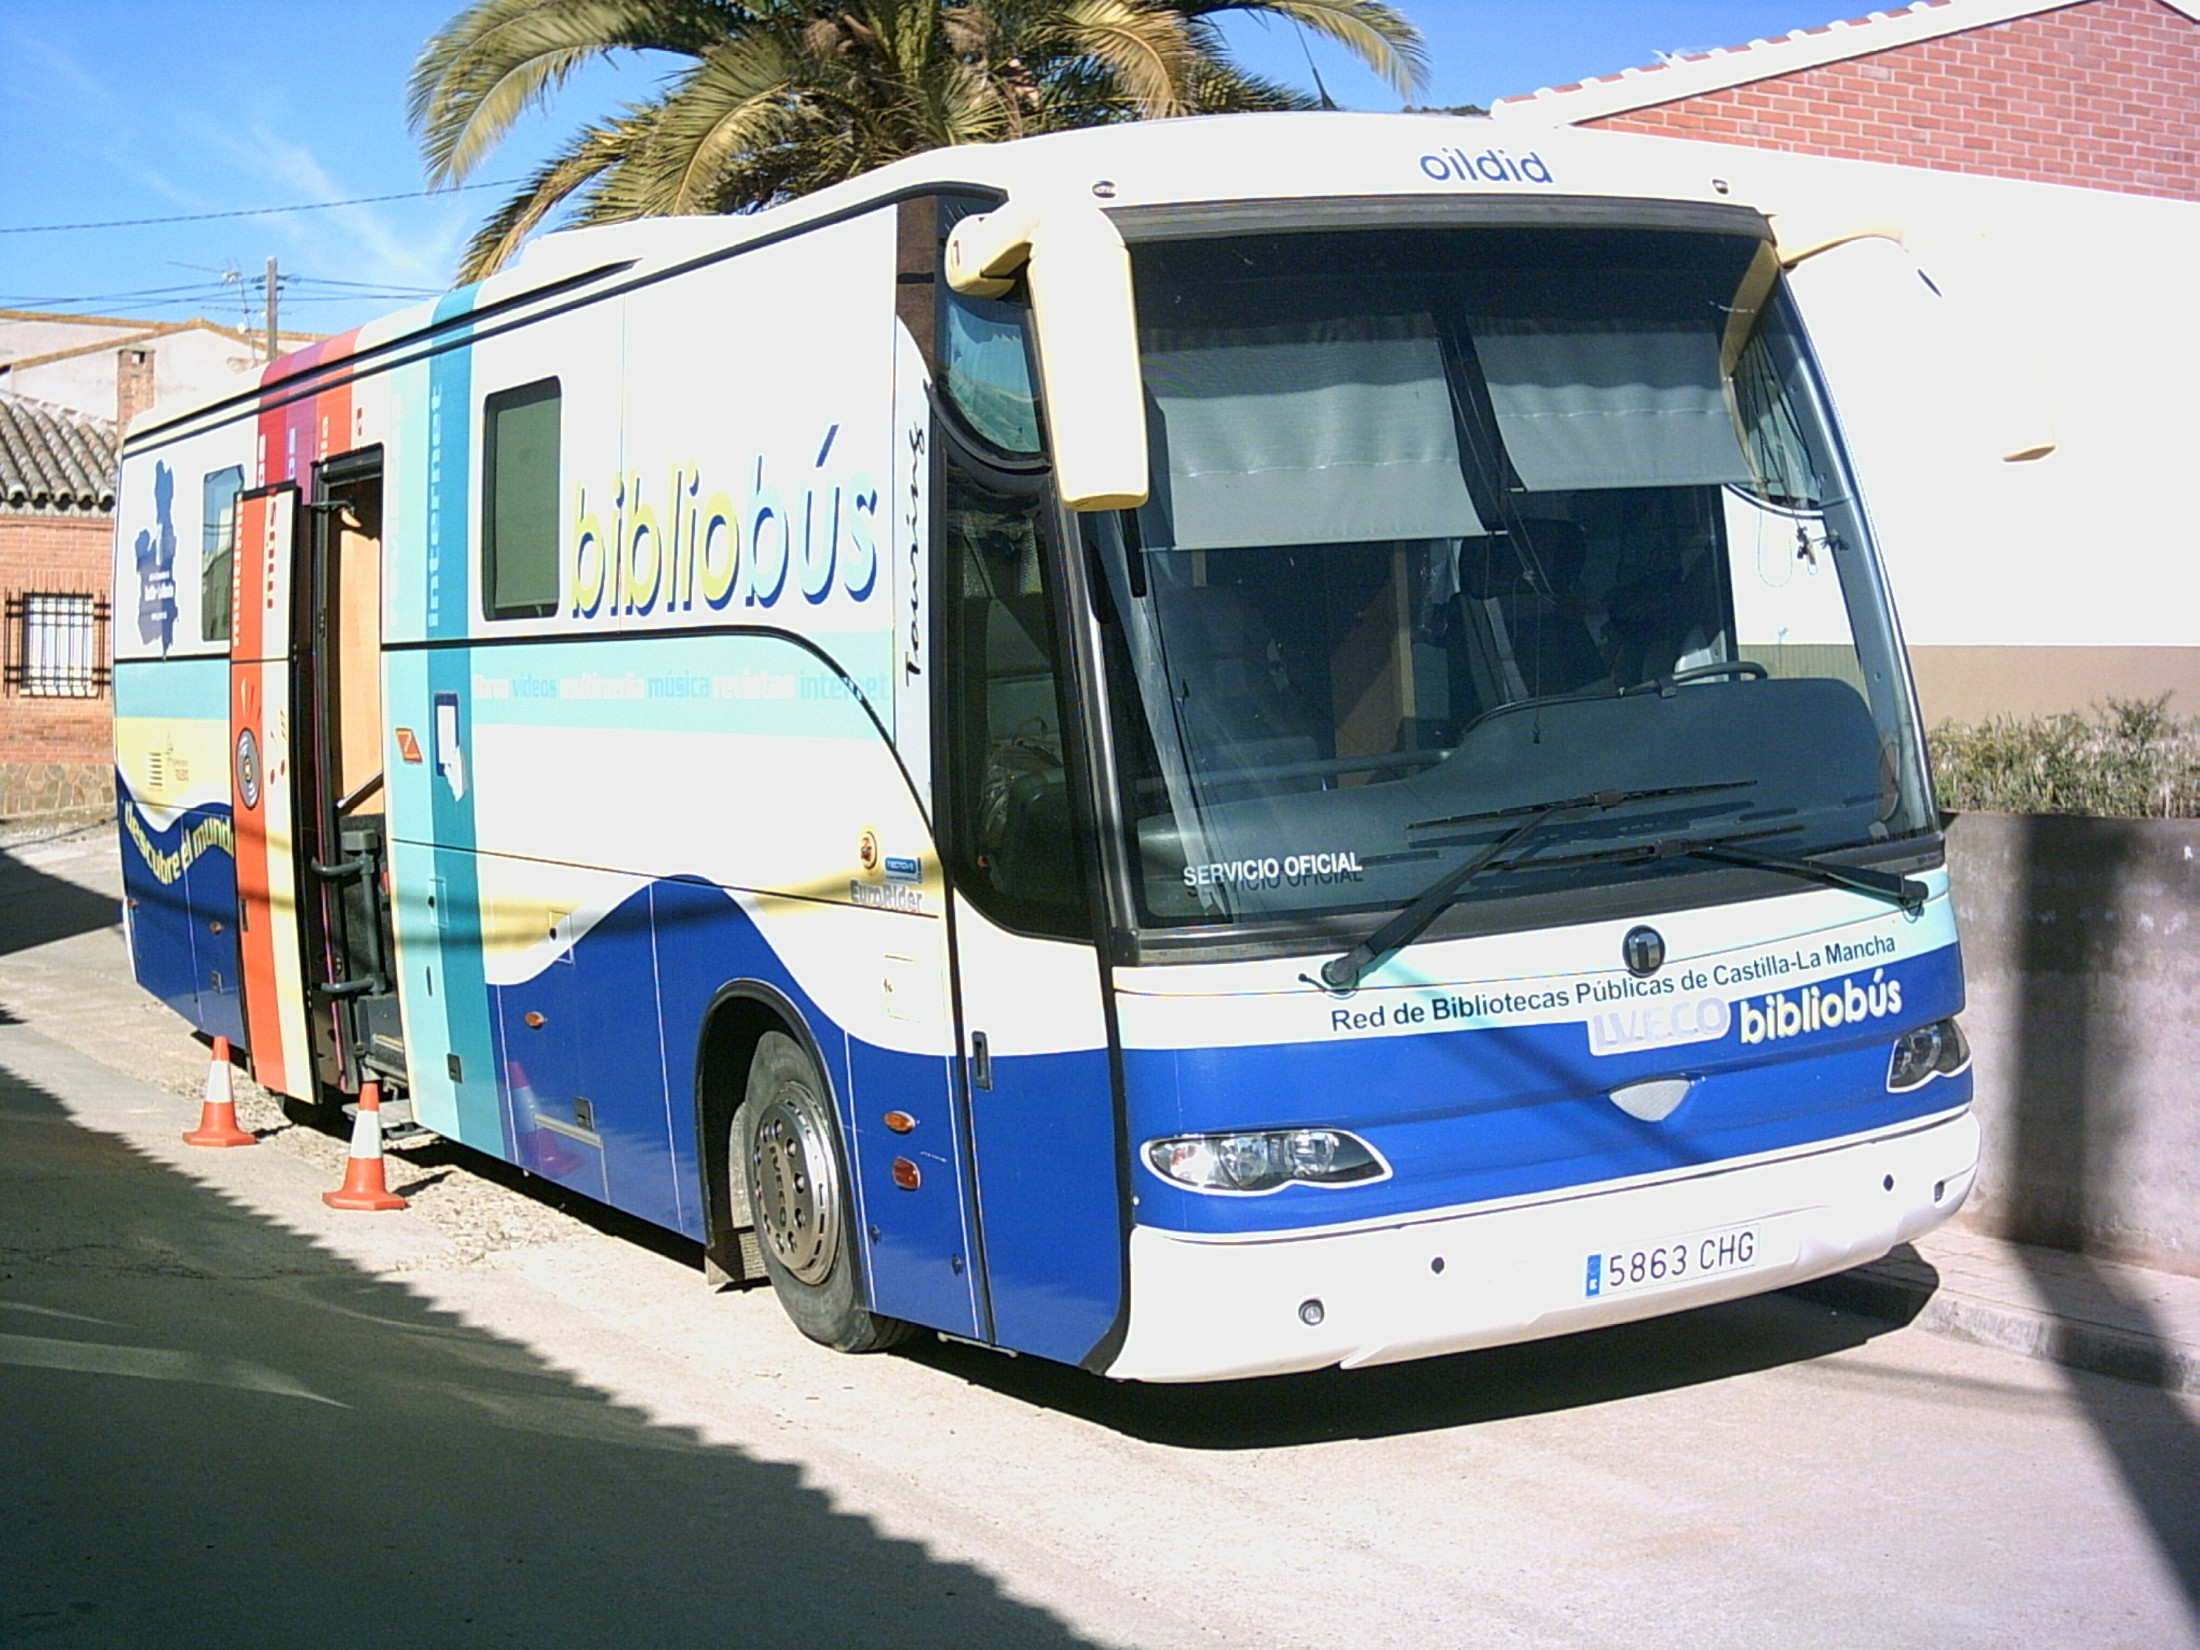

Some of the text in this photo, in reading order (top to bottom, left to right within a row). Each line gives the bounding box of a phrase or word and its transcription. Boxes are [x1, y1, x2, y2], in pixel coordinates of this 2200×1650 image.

[1419, 147, 1554, 183] oildid
[569, 423, 878, 620] bibliobús
[1183, 851, 1364, 887] SERVICIO OFICIAL
[1331, 935, 1896, 1032] Red de Bibliotecas Públicas de Castilla-La Mancha
[1739, 967, 1903, 1044] bibliobús
[1592, 996, 1730, 1046] IVECO
[1609, 1231, 1755, 1287] 5863 CHG
